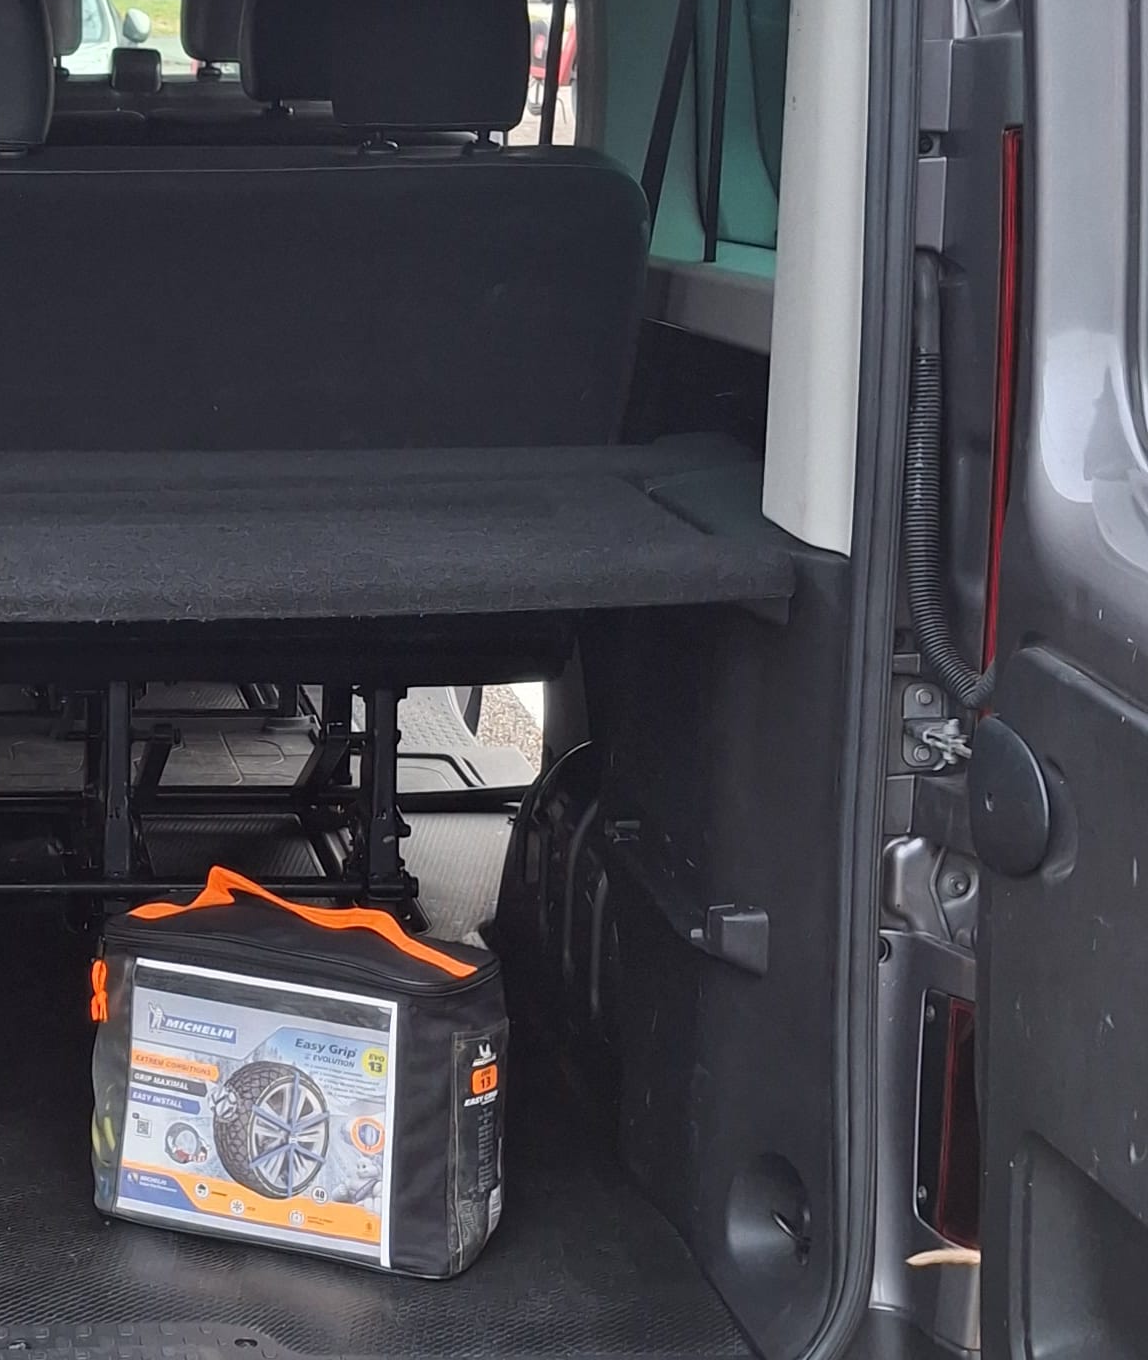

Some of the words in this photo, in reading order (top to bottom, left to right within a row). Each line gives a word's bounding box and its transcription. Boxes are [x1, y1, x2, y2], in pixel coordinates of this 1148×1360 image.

[166, 1018, 234, 1039] MICHELIN
[295, 1038, 326, 1054] Easy
[329, 1044, 356, 1059] Grip
[313, 1054, 355, 1068] EVOLUTION
[368, 1053, 385, 1062] EVO
[368, 1062, 383, 1073] 13
[134, 1072, 152, 1082] GRIP
[153, 1076, 189, 1090] MAXIMAL
[481, 1076, 491, 1089] 13
[132, 1091, 150, 1101] EASY
[152, 1096, 183, 1108] INSTALL
